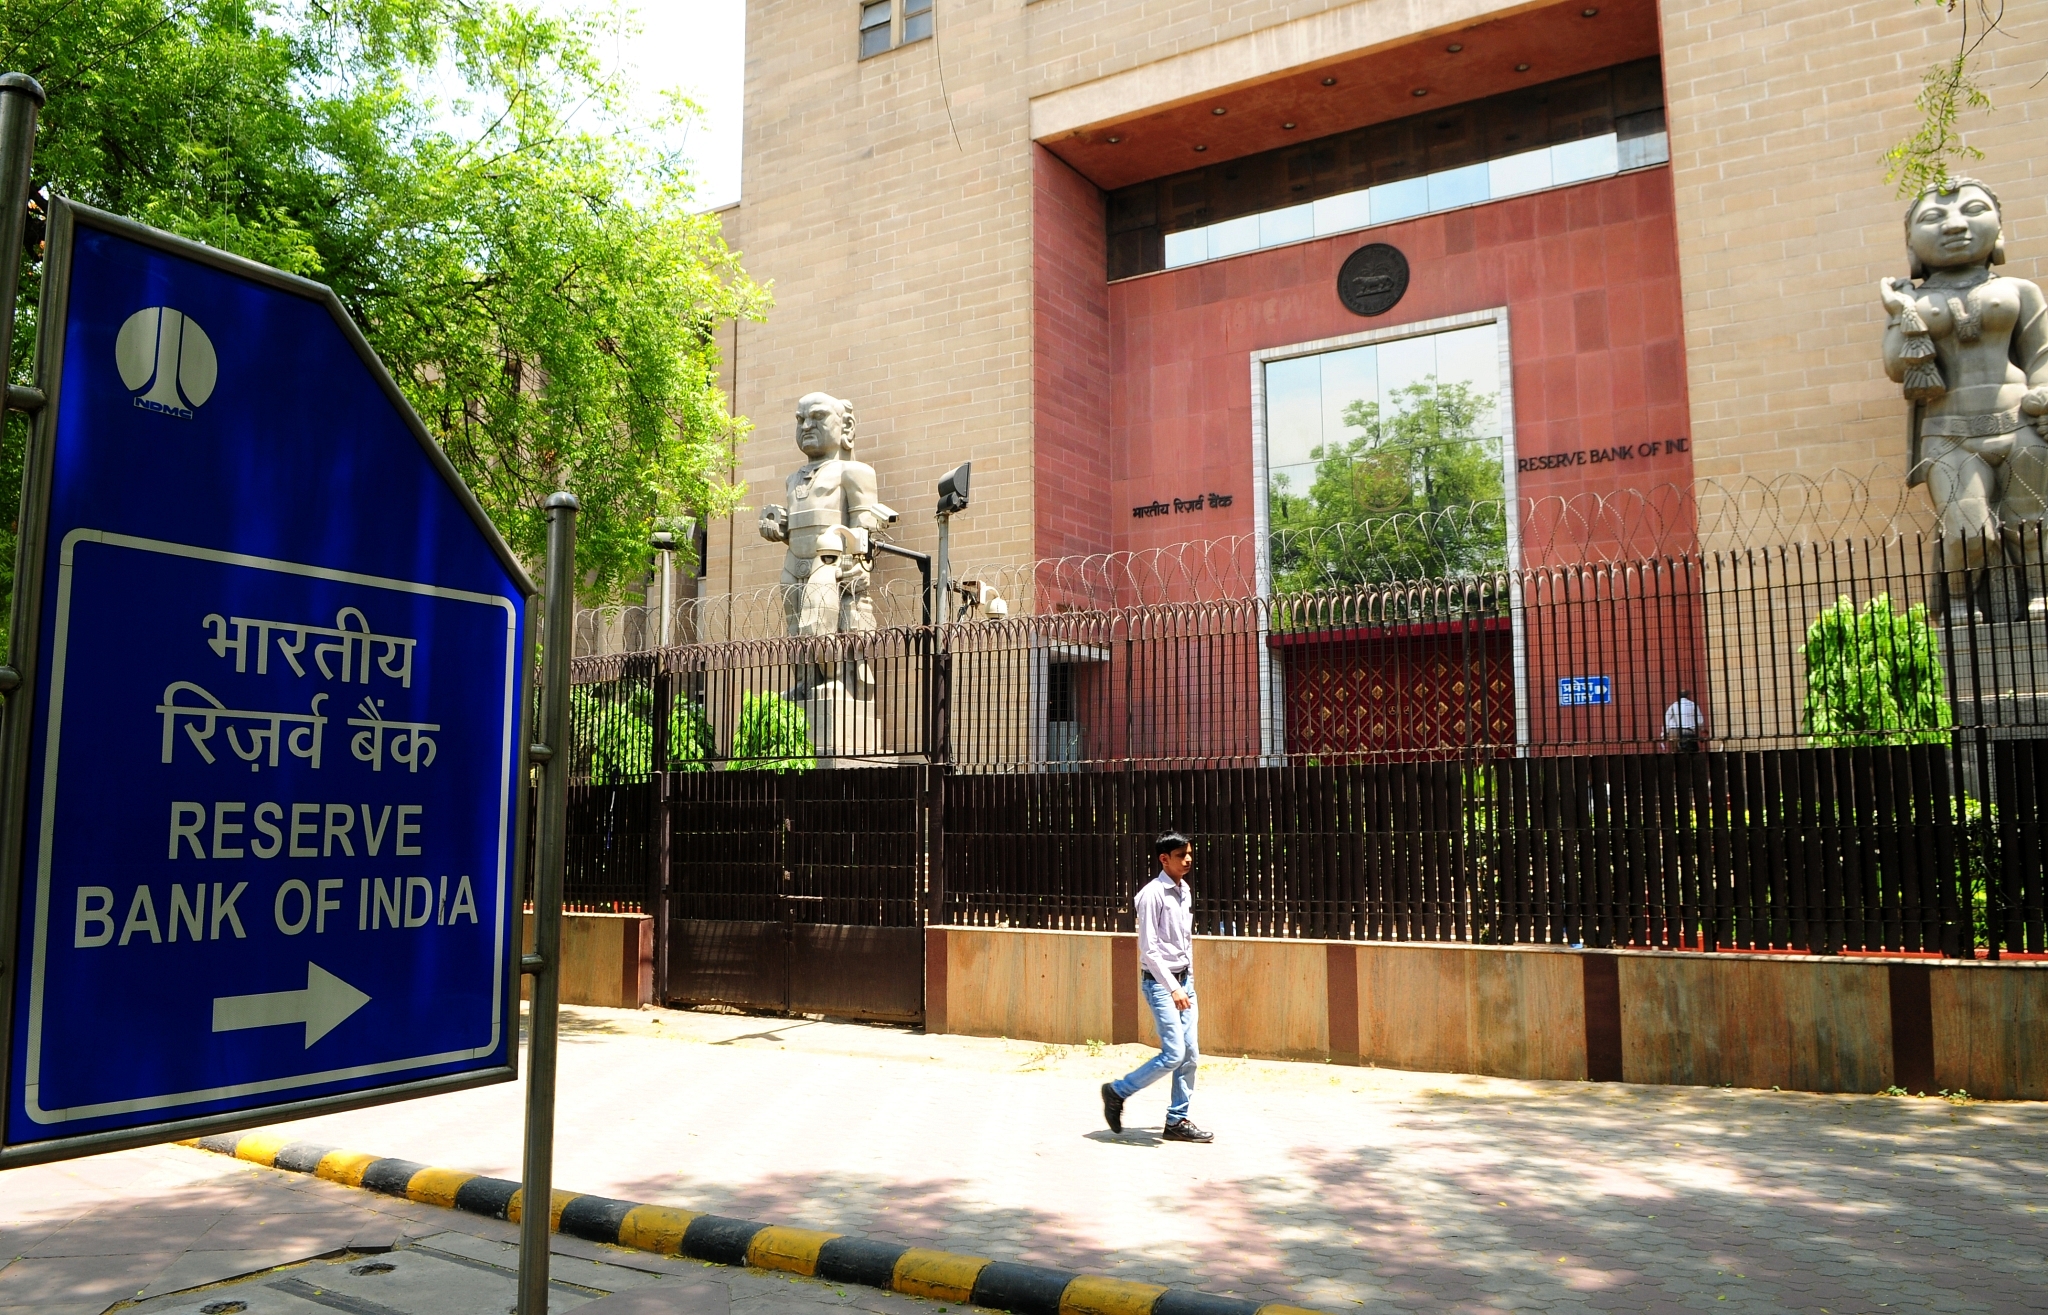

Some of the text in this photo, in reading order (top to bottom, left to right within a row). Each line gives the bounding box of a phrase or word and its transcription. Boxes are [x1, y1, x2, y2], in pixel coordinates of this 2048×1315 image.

[134, 397, 193, 419] NDMC
[1518, 452, 1587, 473] RESERVE
[1590, 445, 1634, 464] BANK
[1638, 442, 1661, 458] OF
[1132, 501, 1170, 518] भारतीय
[1208, 493, 1233, 509] बैंक
[202, 606, 417, 688] भारतीय
[156, 681, 441, 773] रिज़र्व बैंक
[168, 801, 423, 860] RESERVE
[74, 875, 479, 949] BANK OF INDIA
